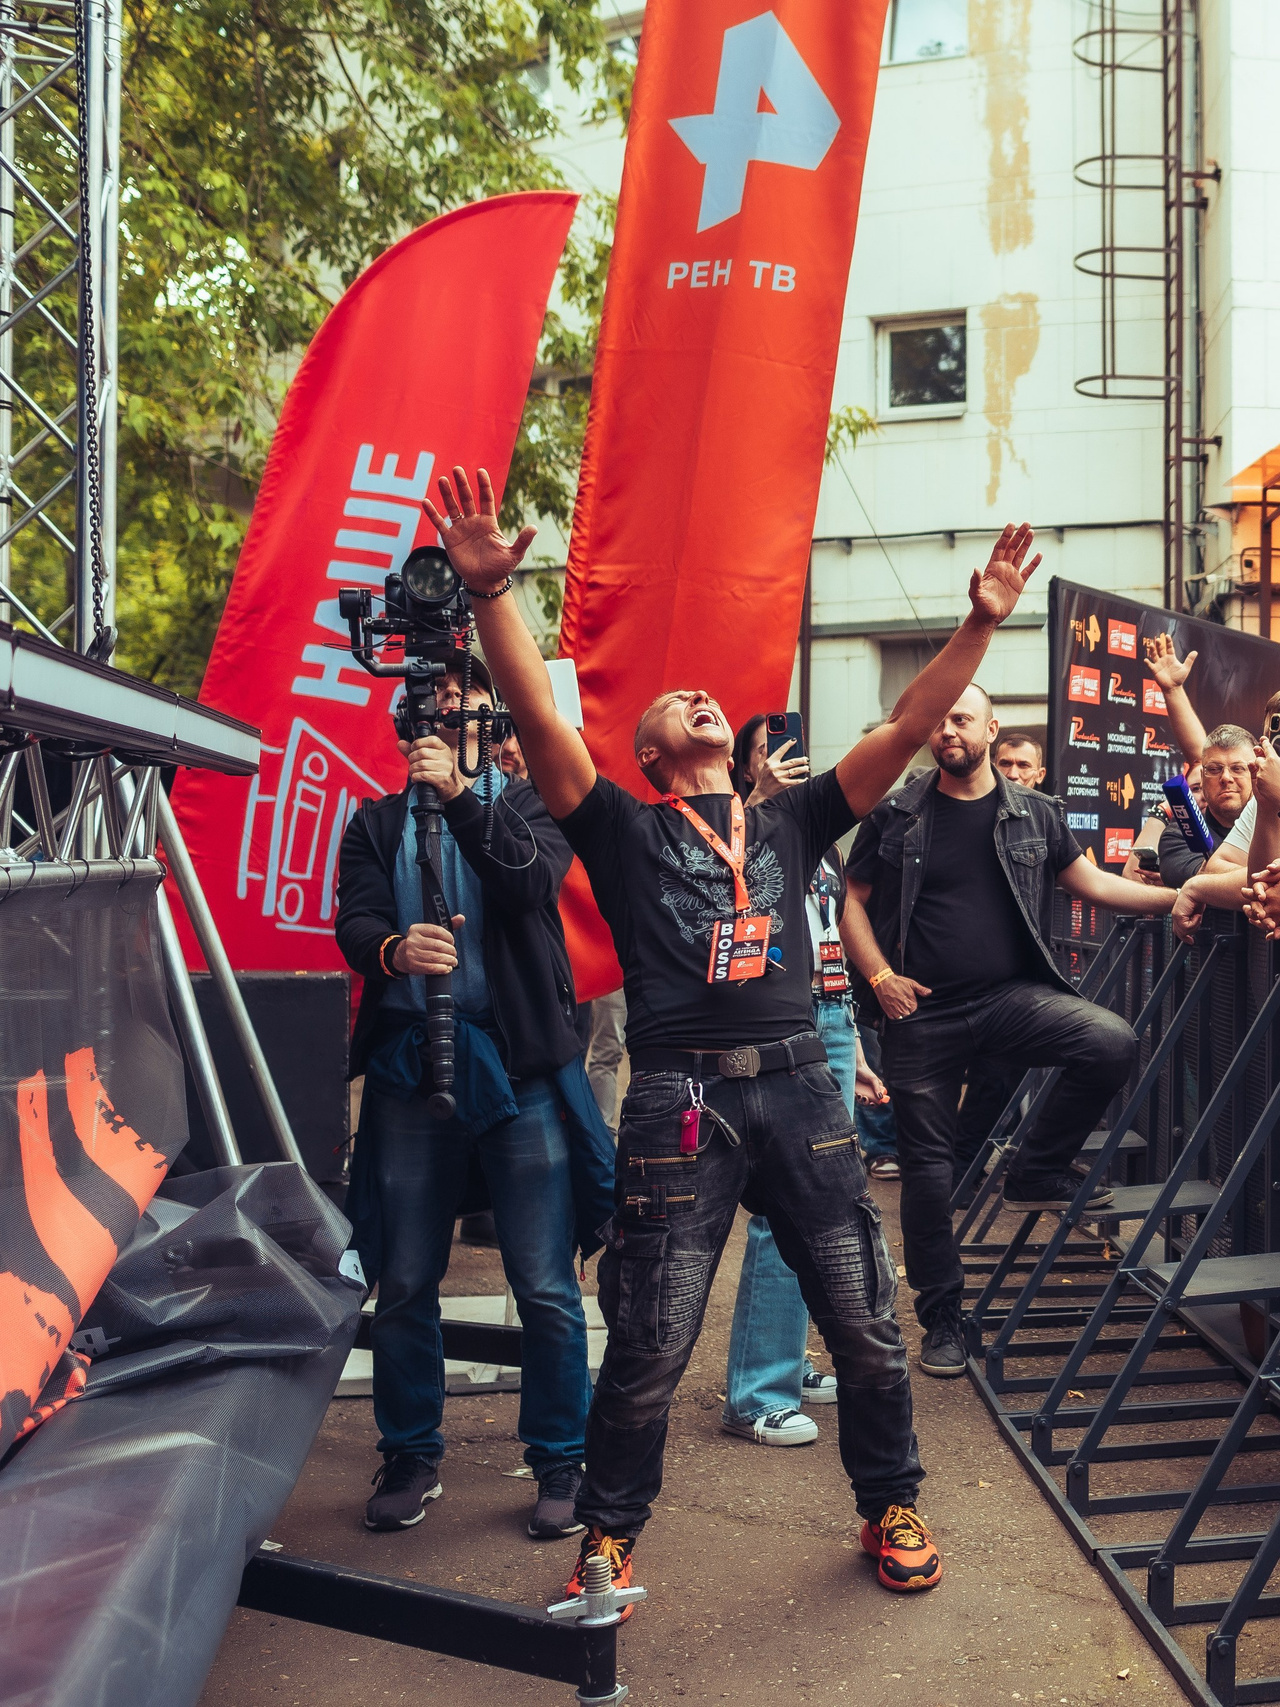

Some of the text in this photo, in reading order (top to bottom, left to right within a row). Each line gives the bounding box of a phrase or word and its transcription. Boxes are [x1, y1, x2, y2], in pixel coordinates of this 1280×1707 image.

[666, 258, 797, 293] РЕН ТВ
[1070, 619, 1083, 631] РЕН
[1075, 631, 1082, 642] ТВ
[1067, 775, 1099, 787] МОСКОНЦЕРТ
[1106, 781, 1118, 791] РЕН
[1110, 791, 1118, 802] ТВ
[433, 894, 449, 929] ITZO
[715, 923, 734, 979] BOSS
